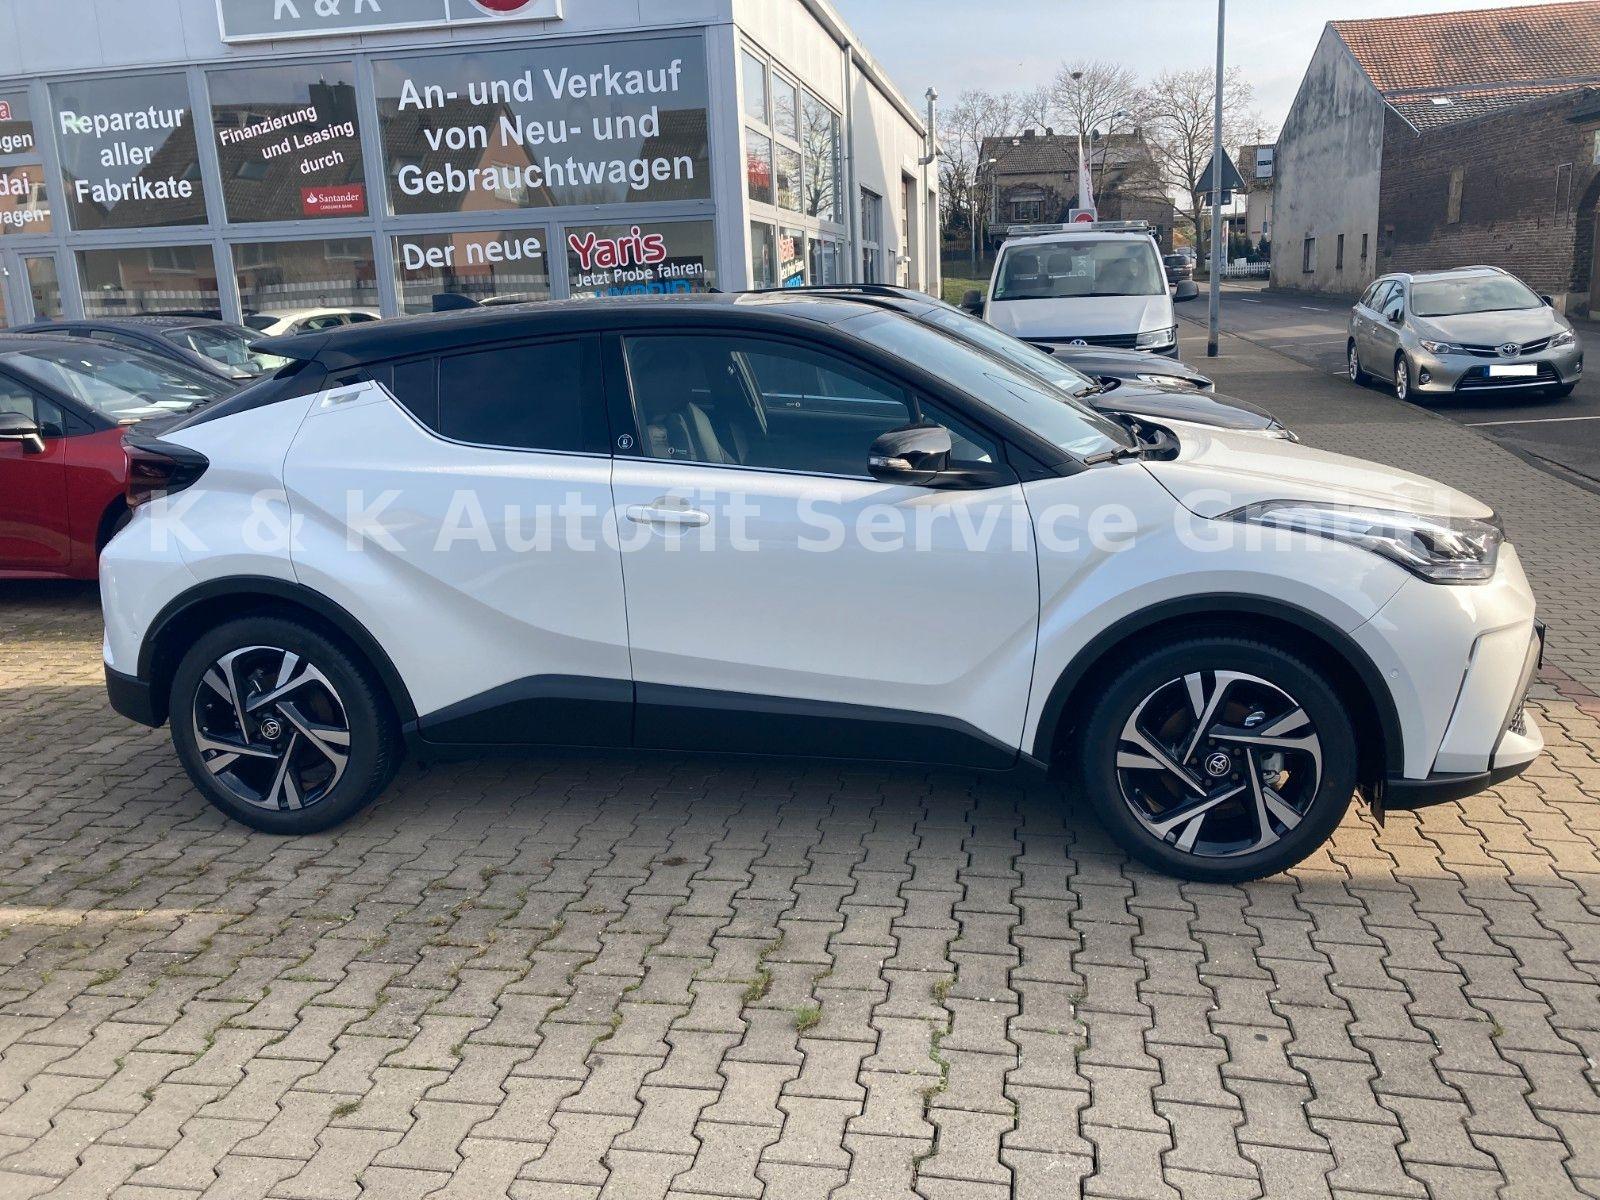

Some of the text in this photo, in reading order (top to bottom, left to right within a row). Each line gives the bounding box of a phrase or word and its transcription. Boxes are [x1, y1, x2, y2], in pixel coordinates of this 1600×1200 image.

[398, 59, 682, 111] An- und Verkauf
[59, 105, 184, 138] Reparatur
[219, 106, 318, 146] Finanzierung
[424, 106, 660, 151] von Neu- und
[0, 133, 33, 153] gen
[100, 141, 154, 167] aller
[262, 121, 355, 159] und Leasing
[300, 150, 344, 175] durch
[398, 155, 694, 195] Gebrauchtwagen
[75, 175, 193, 203] Fabrikate
[318, 191, 360, 203] Santander
[402, 237, 542, 271] Der neue
[568, 226, 667, 270] Yaris
[576, 262, 708, 288] Jetzt Probe fahren.
